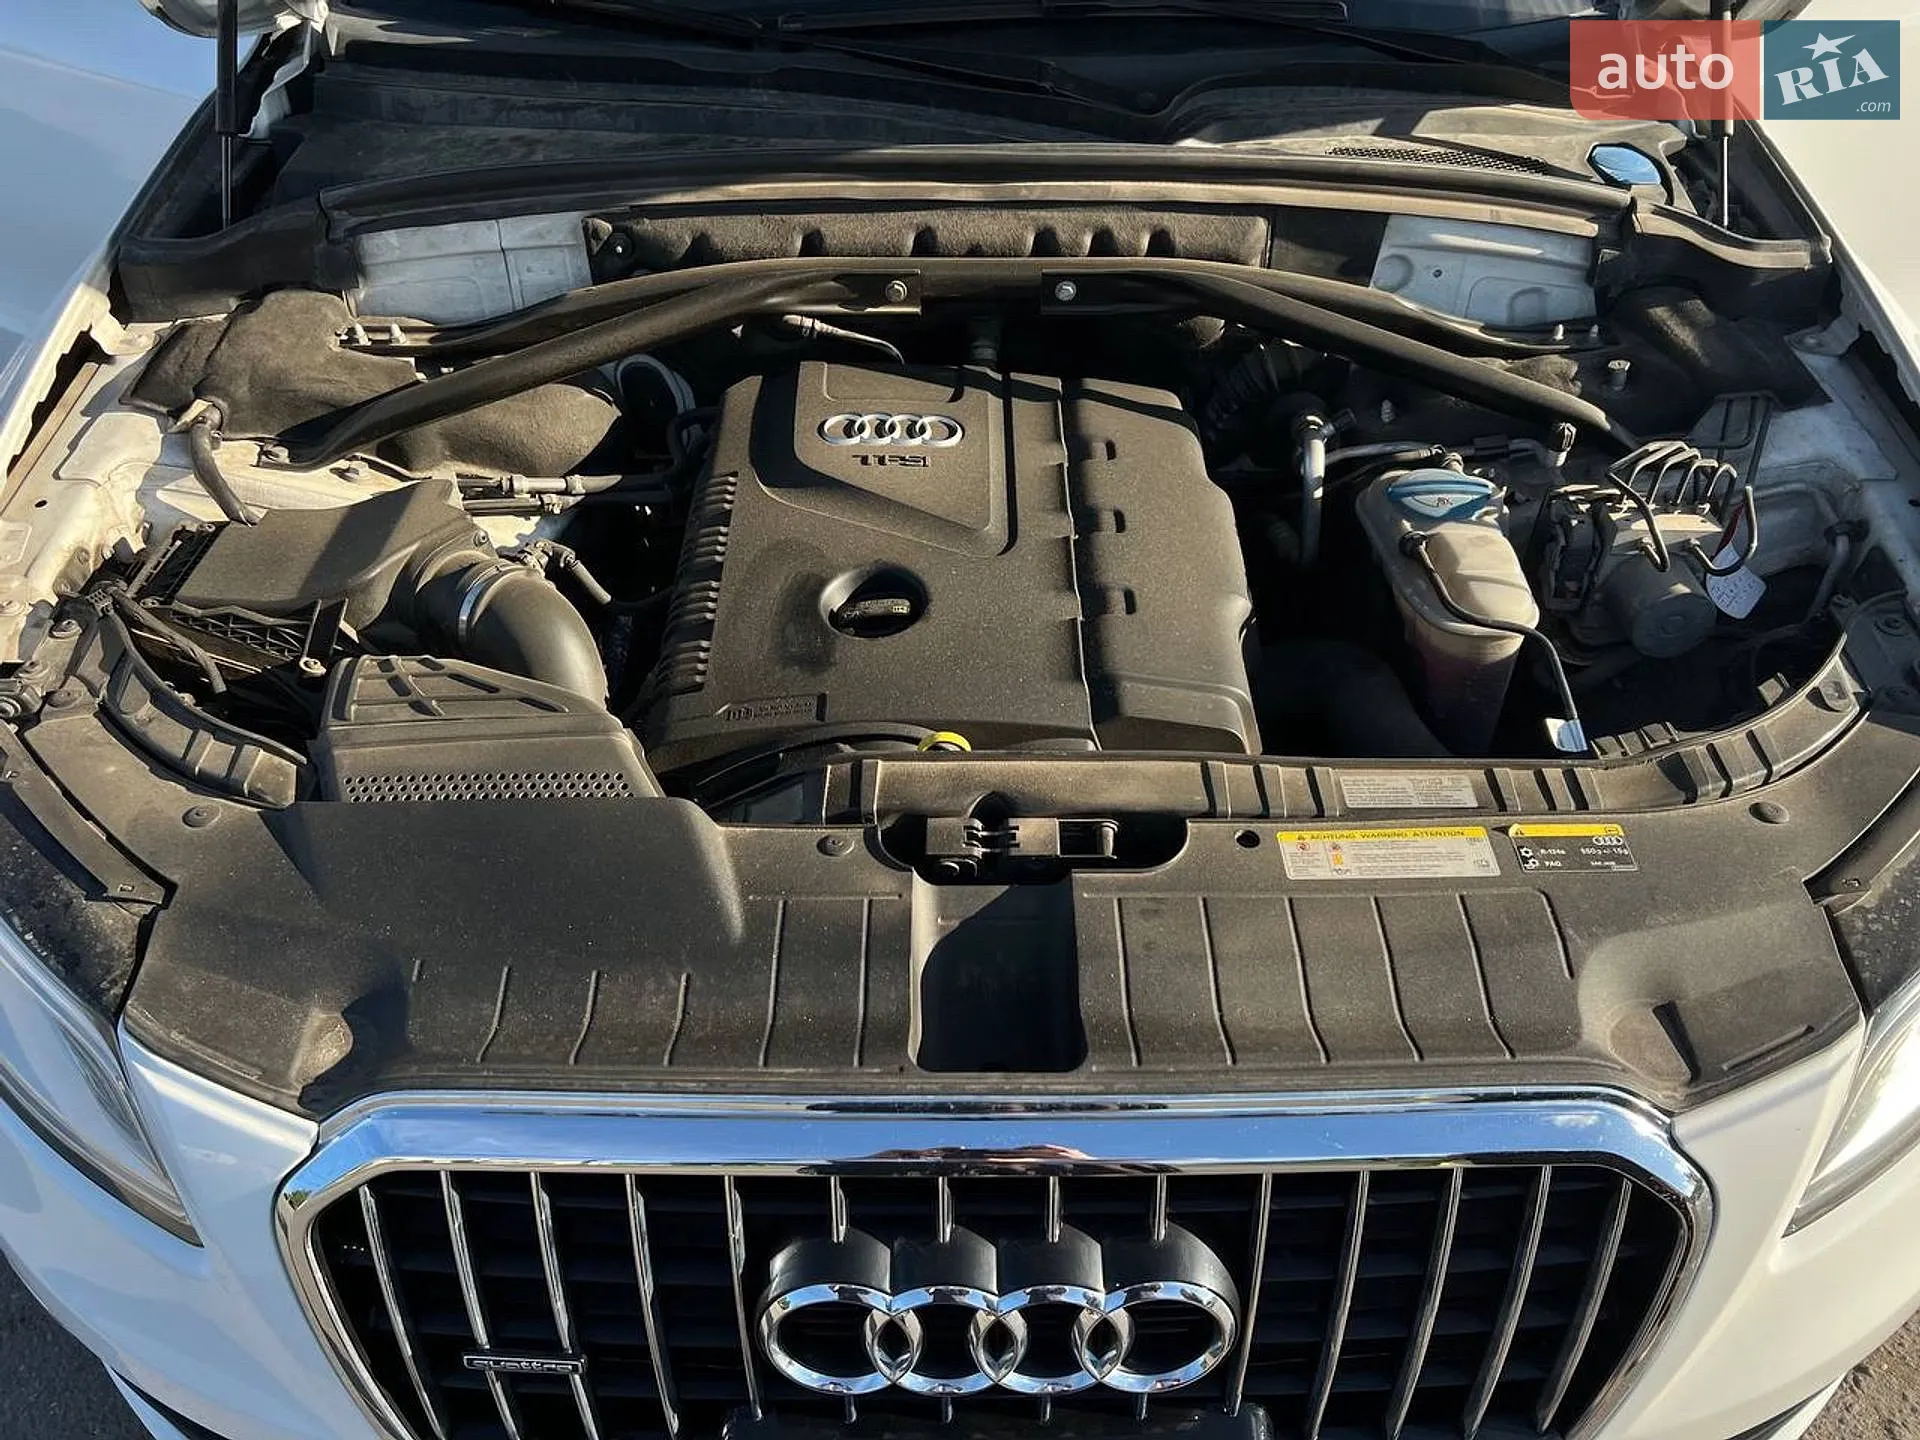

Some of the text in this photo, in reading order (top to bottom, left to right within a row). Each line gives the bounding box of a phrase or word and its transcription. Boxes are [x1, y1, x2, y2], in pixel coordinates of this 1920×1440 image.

[1361, 831, 1408, 839] WARNING
[1412, 829, 1466, 838] ATTENTION
[472, 1360, 573, 1372] quattro
